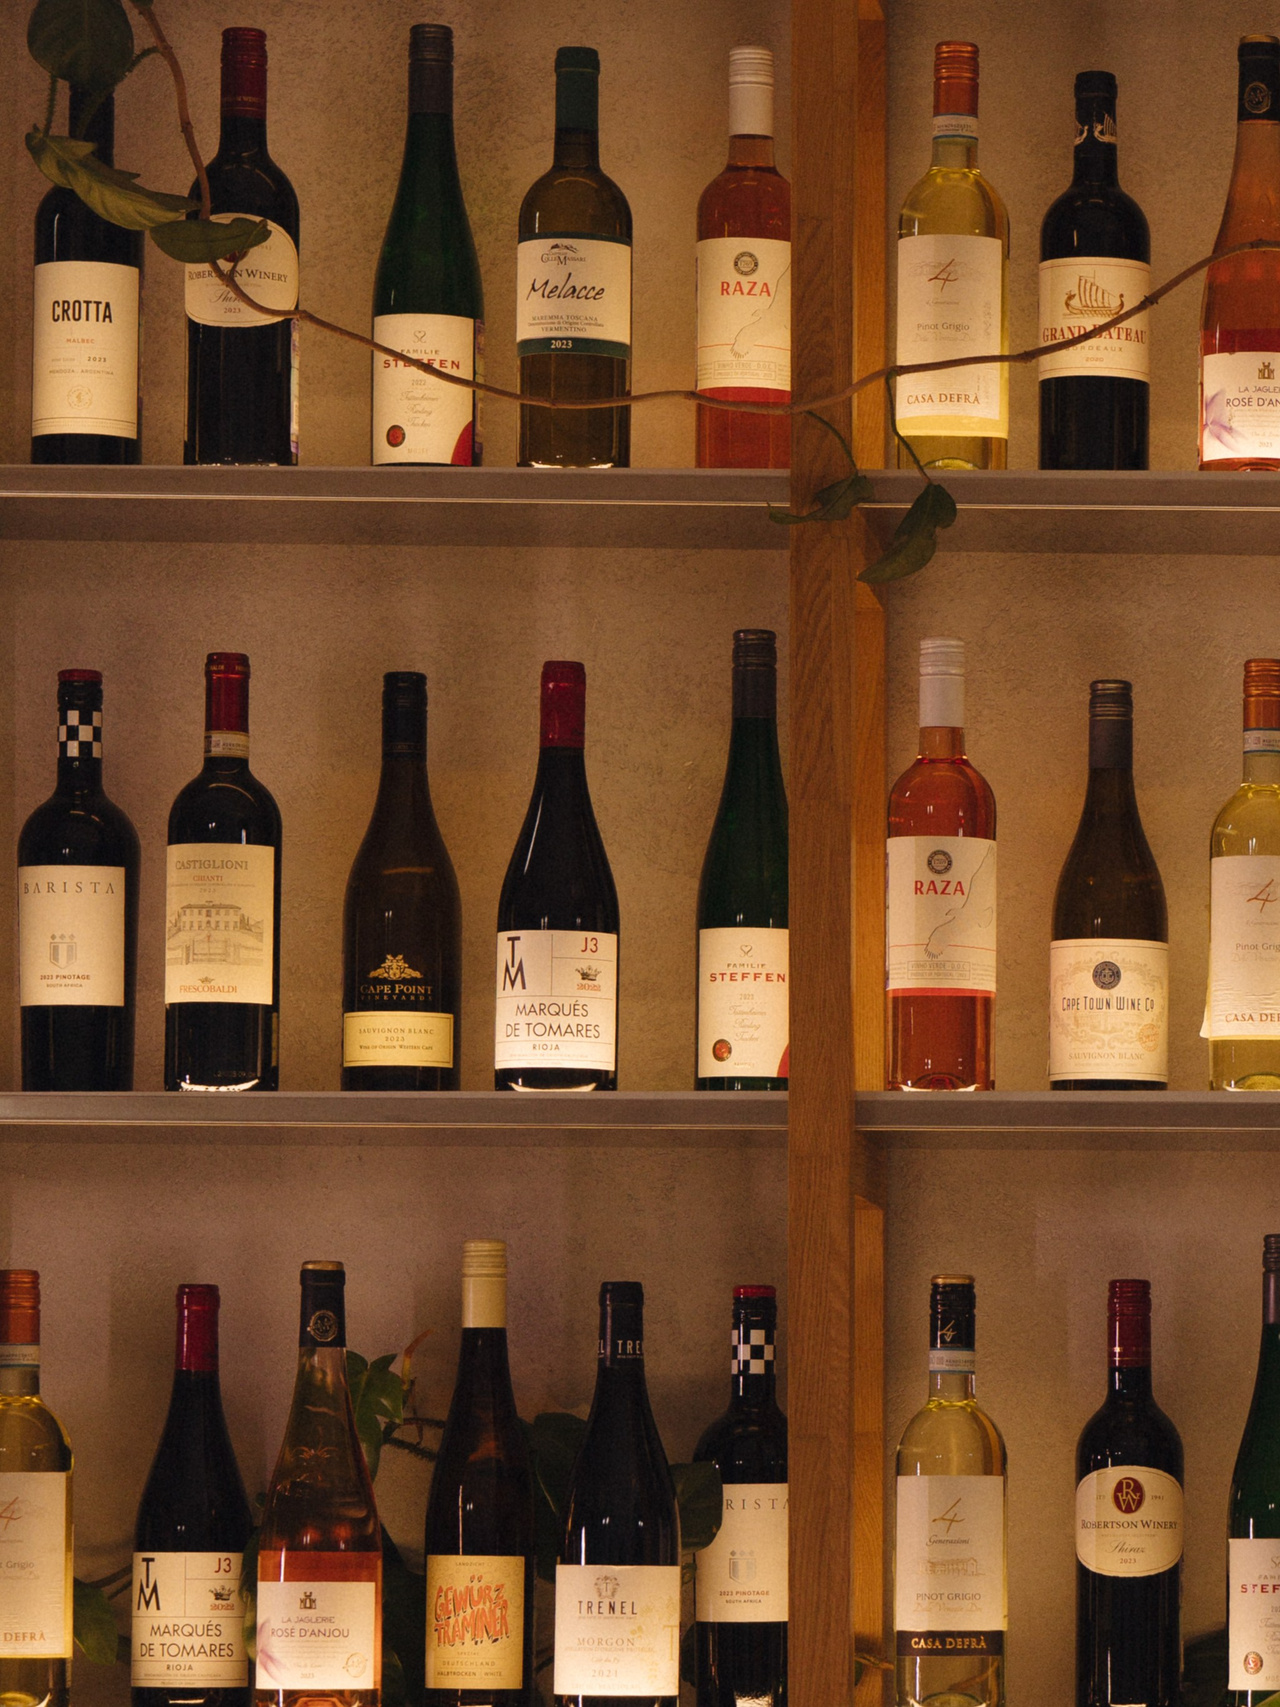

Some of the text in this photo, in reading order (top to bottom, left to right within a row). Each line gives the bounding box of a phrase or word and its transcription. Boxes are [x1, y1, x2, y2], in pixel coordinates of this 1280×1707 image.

[246, 269, 288, 283] WINERY
[928, 258, 958, 292] 4
[527, 273, 605, 300] Melacce
[720, 281, 771, 298] RAZA
[51, 300, 112, 324] CROTTA
[917, 322, 970, 333] Pinot Grigio
[551, 340, 572, 349] 2023
[1238, 386, 1250, 394] LA
[907, 391, 980, 405] CASA DEFRÀ
[1226, 396, 1252, 408] ROSÉ
[175, 860, 249, 871] CASTIGLIONI
[24, 881, 115, 895] BARISTA
[914, 880, 965, 896] RAZA
[1247, 879, 1277, 913] 4
[581, 937, 598, 954] J3
[710, 972, 785, 983] STEFFEN
[179, 984, 237, 994] FRESCOBALDI
[360, 984, 433, 995] CAPE POINT
[576, 983, 601, 992] 2022
[515, 1001, 588, 1017] MARQUÉS
[1225, 1012, 1256, 1023] CASA
[506, 1022, 600, 1040] DE TOMARES
[932, 1498, 965, 1533] 4
[1081, 1519, 1178, 1530] ROBERTSON WINERY
[926, 1535, 970, 1547] Generazioni
[6, 1560, 34, 1570] Grigio
[214, 1558, 232, 1573] J3
[435, 1574, 506, 1622] GEWÜRZ
[578, 1599, 637, 1616] TRENEL
[149, 1621, 222, 1637] MARQUÉS
[434, 1599, 510, 1647] TRAMINER
[4, 1631, 46, 1641] DEFRÀ
[271, 1626, 350, 1638] ROSÉ D'ANJOU
[577, 1637, 636, 1647] MORGON
[911, 1635, 987, 1649] CASA DEFRÀ
[140, 1643, 233, 1657] DE TOMARES
